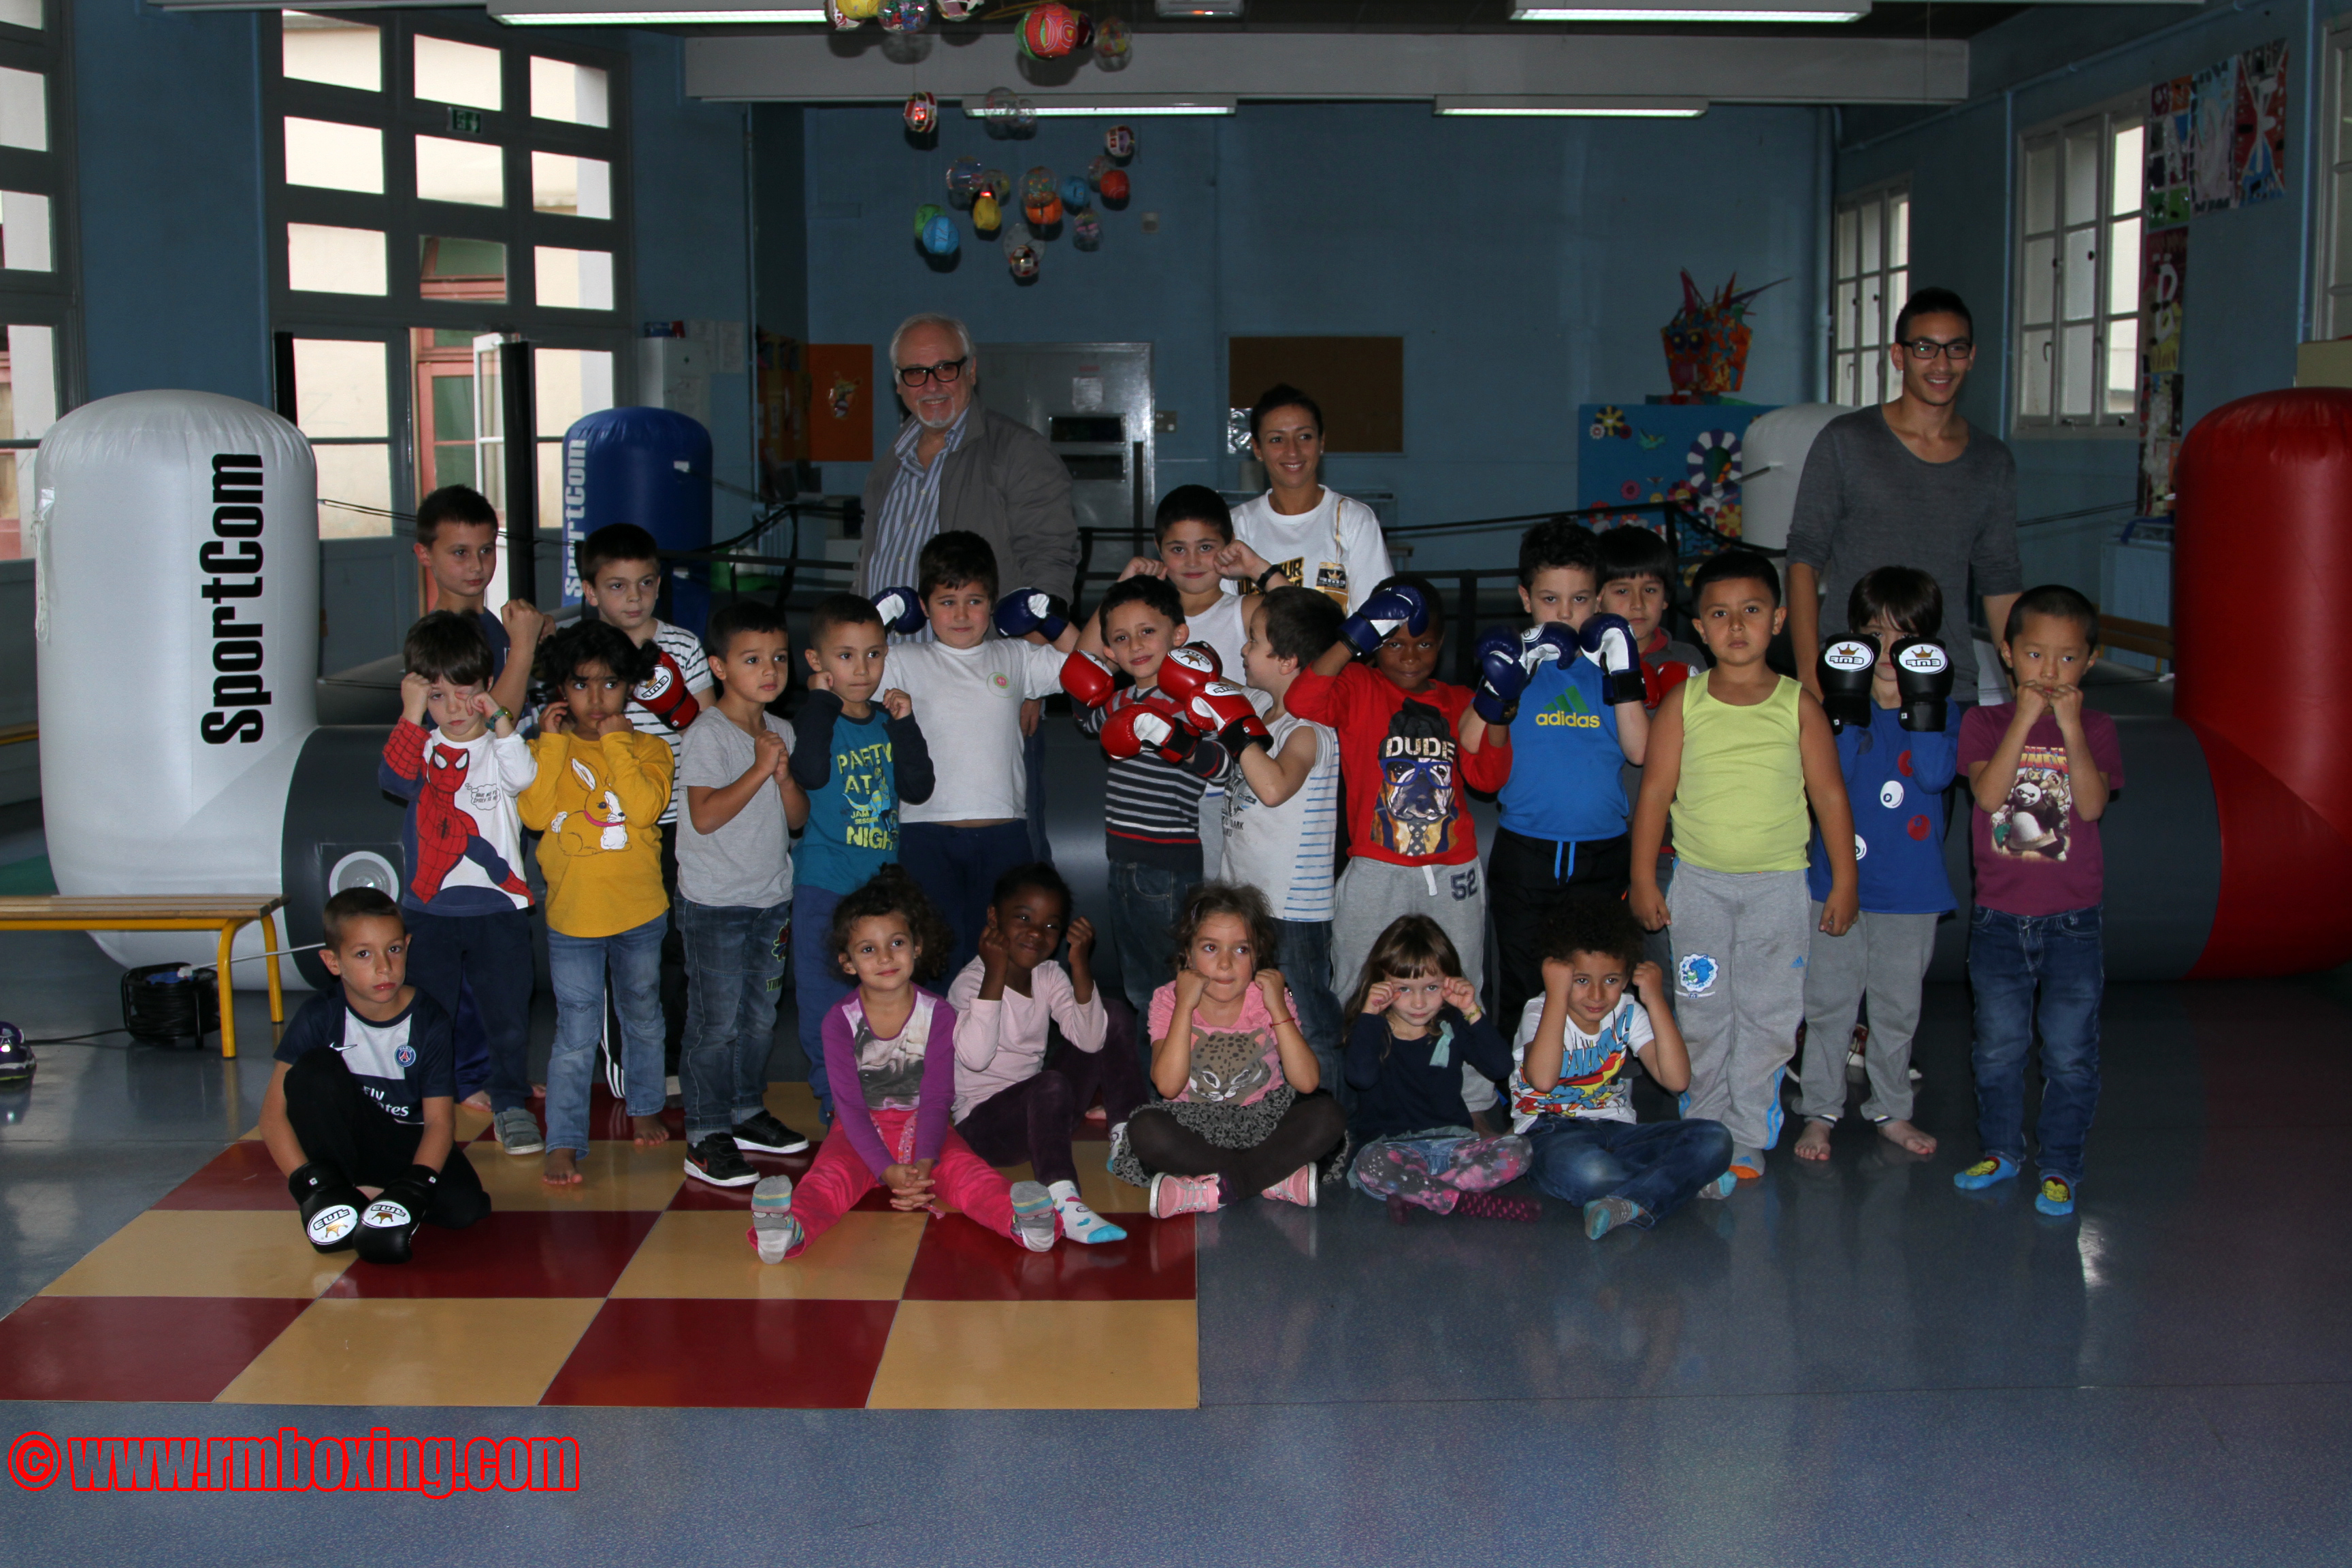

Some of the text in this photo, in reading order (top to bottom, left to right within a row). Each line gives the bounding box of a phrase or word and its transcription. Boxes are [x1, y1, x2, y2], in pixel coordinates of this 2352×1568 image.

[199, 453, 272, 744] SportCom
[1829, 655, 1864, 665] RMB
[1906, 658, 1941, 667] RMB
[1535, 710, 1601, 728] adidas
[836, 742, 892, 775] PARTY
[1386, 736, 1455, 762] DUDE
[844, 774, 872, 796] AT
[851, 810, 870, 819] JAM
[846, 826, 893, 851] NIGH
[1450, 868, 1477, 902] 52
